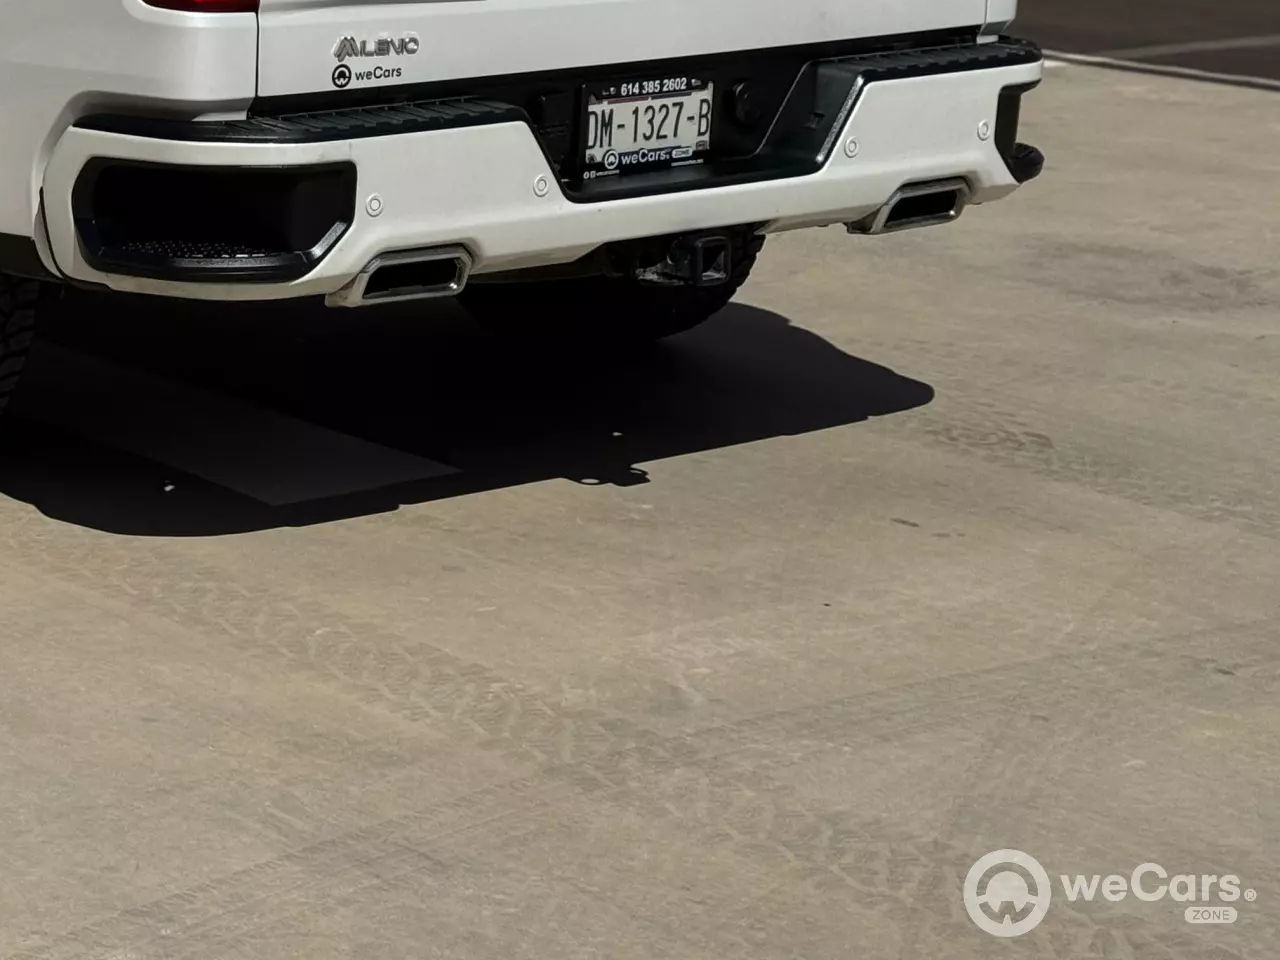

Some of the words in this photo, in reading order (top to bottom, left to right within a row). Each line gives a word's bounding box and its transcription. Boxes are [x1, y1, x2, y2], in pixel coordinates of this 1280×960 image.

[355, 66, 402, 81] weCars
[620, 82, 640, 96] 614
[642, 80, 660, 94] 385
[663, 77, 687, 92] 2602
